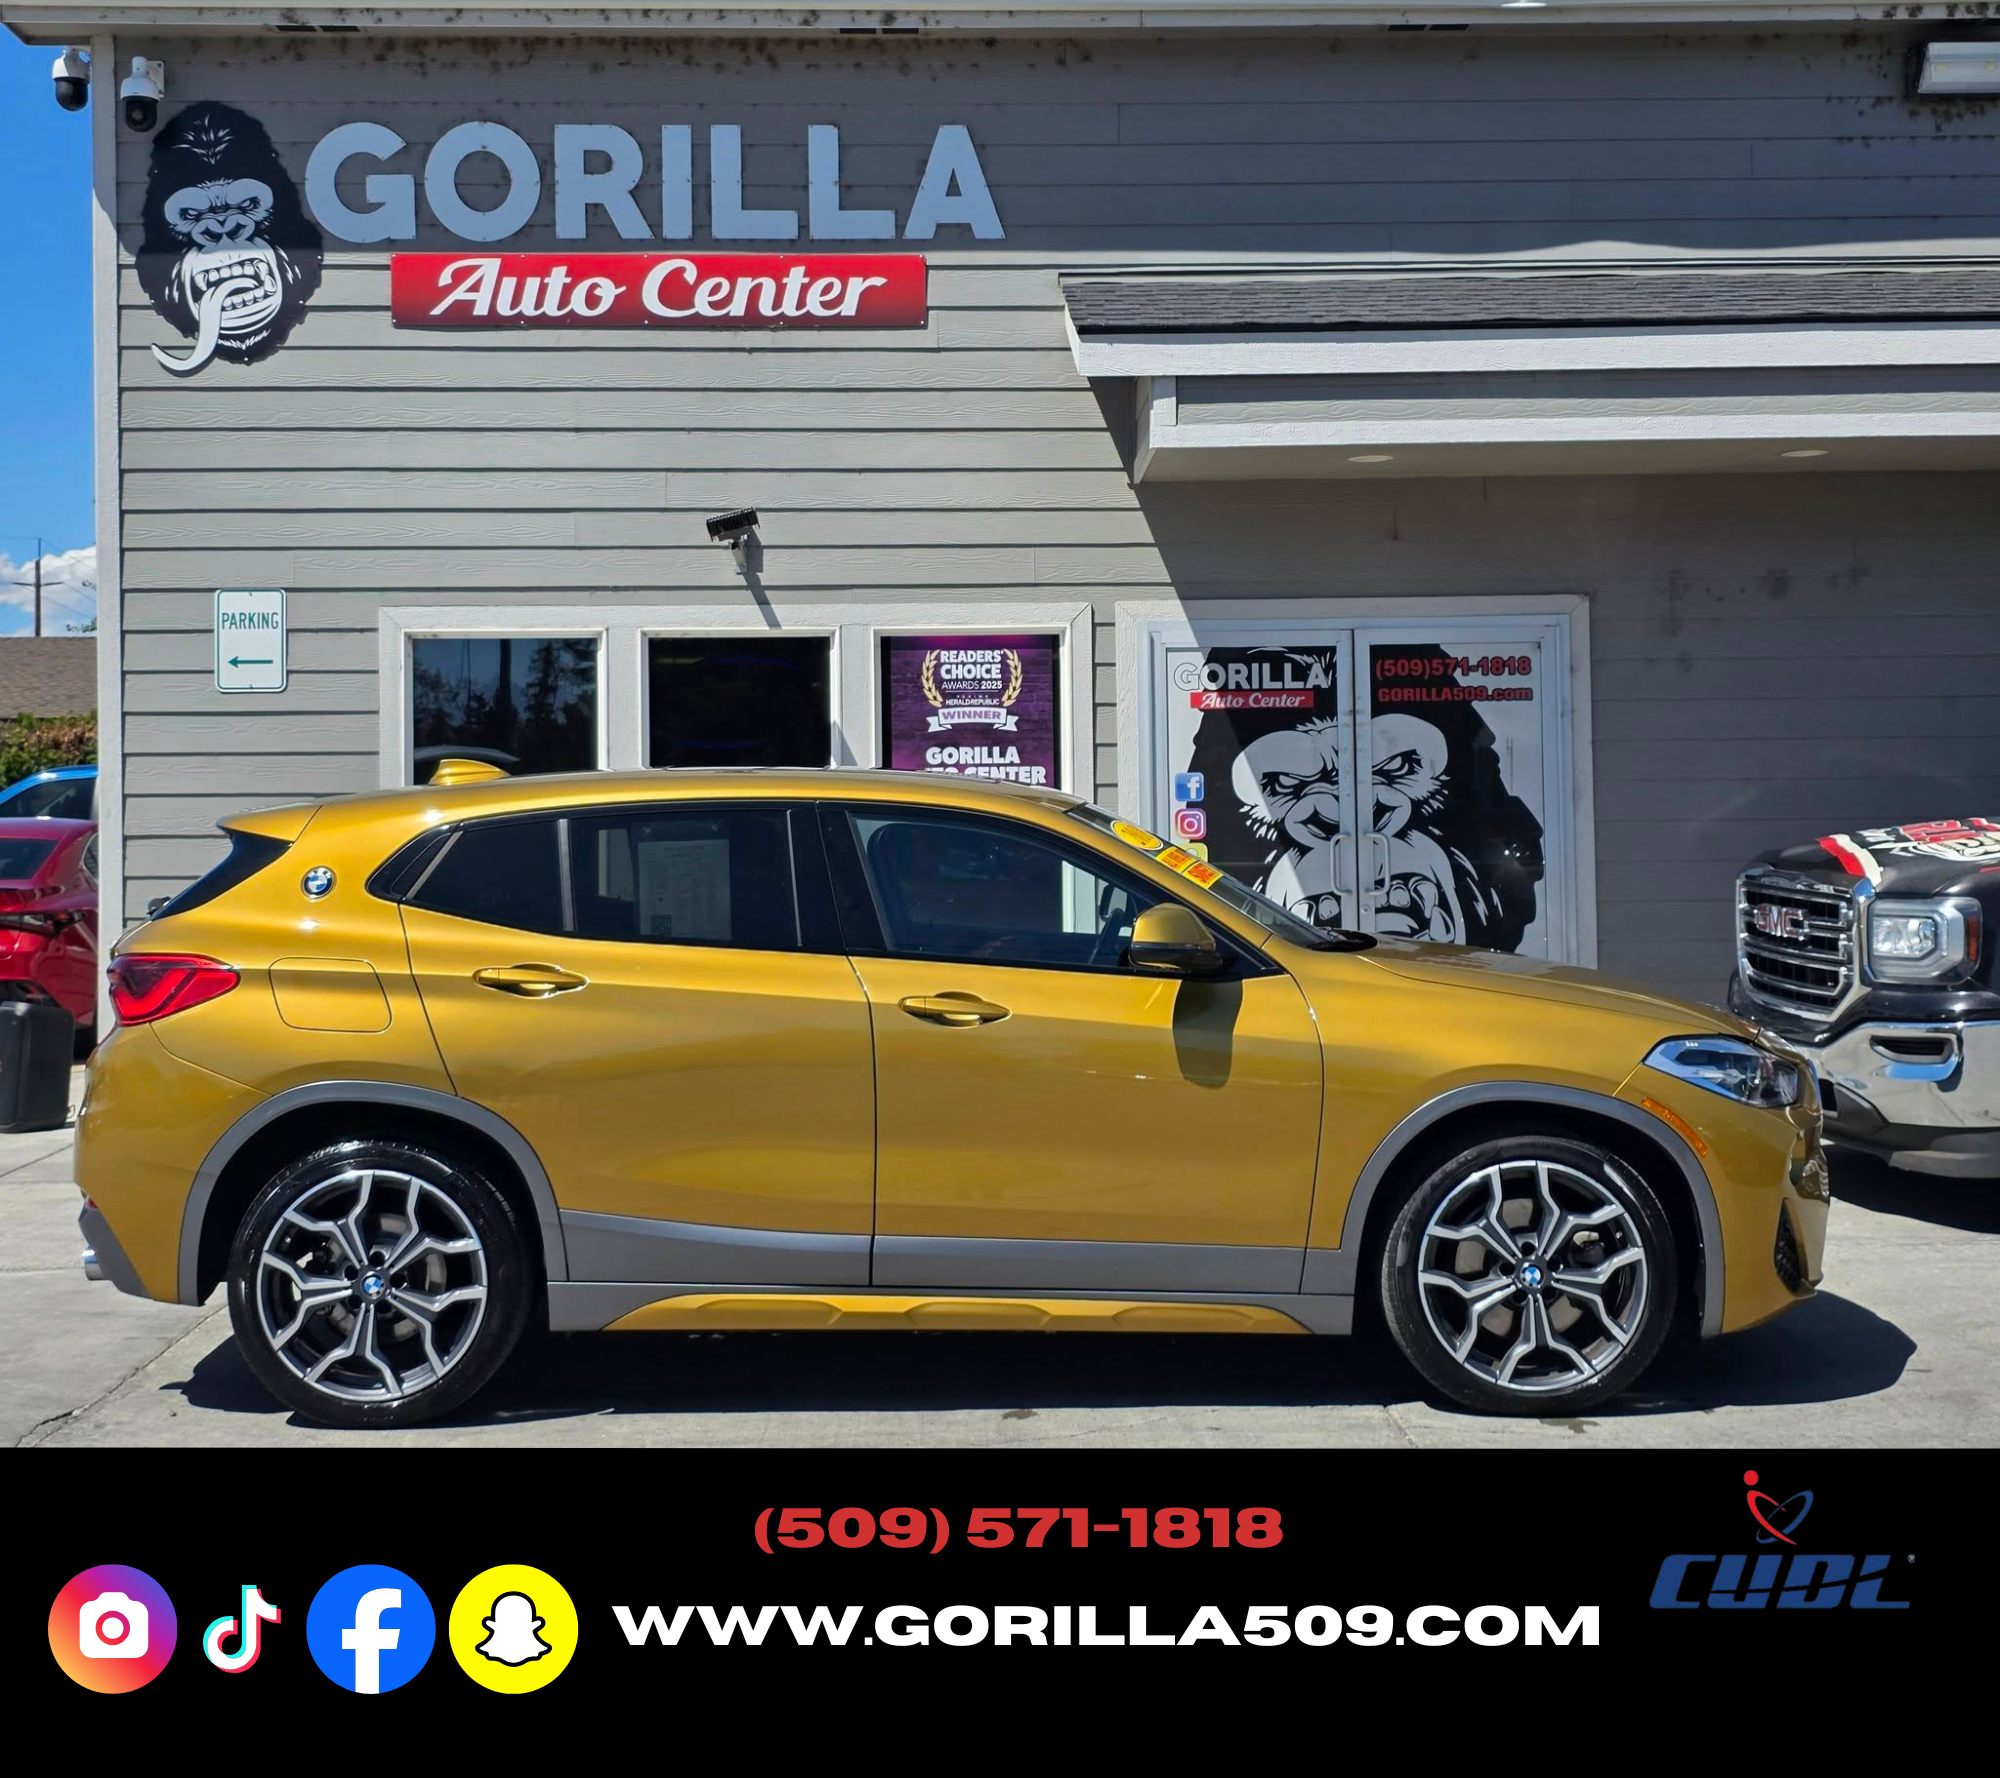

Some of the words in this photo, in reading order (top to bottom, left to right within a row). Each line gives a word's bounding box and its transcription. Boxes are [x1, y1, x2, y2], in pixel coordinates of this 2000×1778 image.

[304, 120, 1006, 243] GORILLA
[429, 257, 625, 317] Auto
[641, 258, 886, 318] Center
[221, 612, 279, 630] PARKING
[940, 649, 1004, 663] READERS'
[940, 664, 1002, 679] CHOICE
[1173, 662, 1330, 691] GORILLA
[1375, 655, 1533, 681] (509)571-1818
[941, 681, 980, 690] AWARDS
[981, 680, 1003, 690] 2025
[1377, 685, 1534, 703] GORILLA509.com
[1200, 692, 1244, 709] Auto
[1248, 692, 1306, 709] Center
[941, 709, 1002, 720] WINNER
[926, 746, 1020, 765] GORILLA
[1754, 903, 1804, 941] GMC
